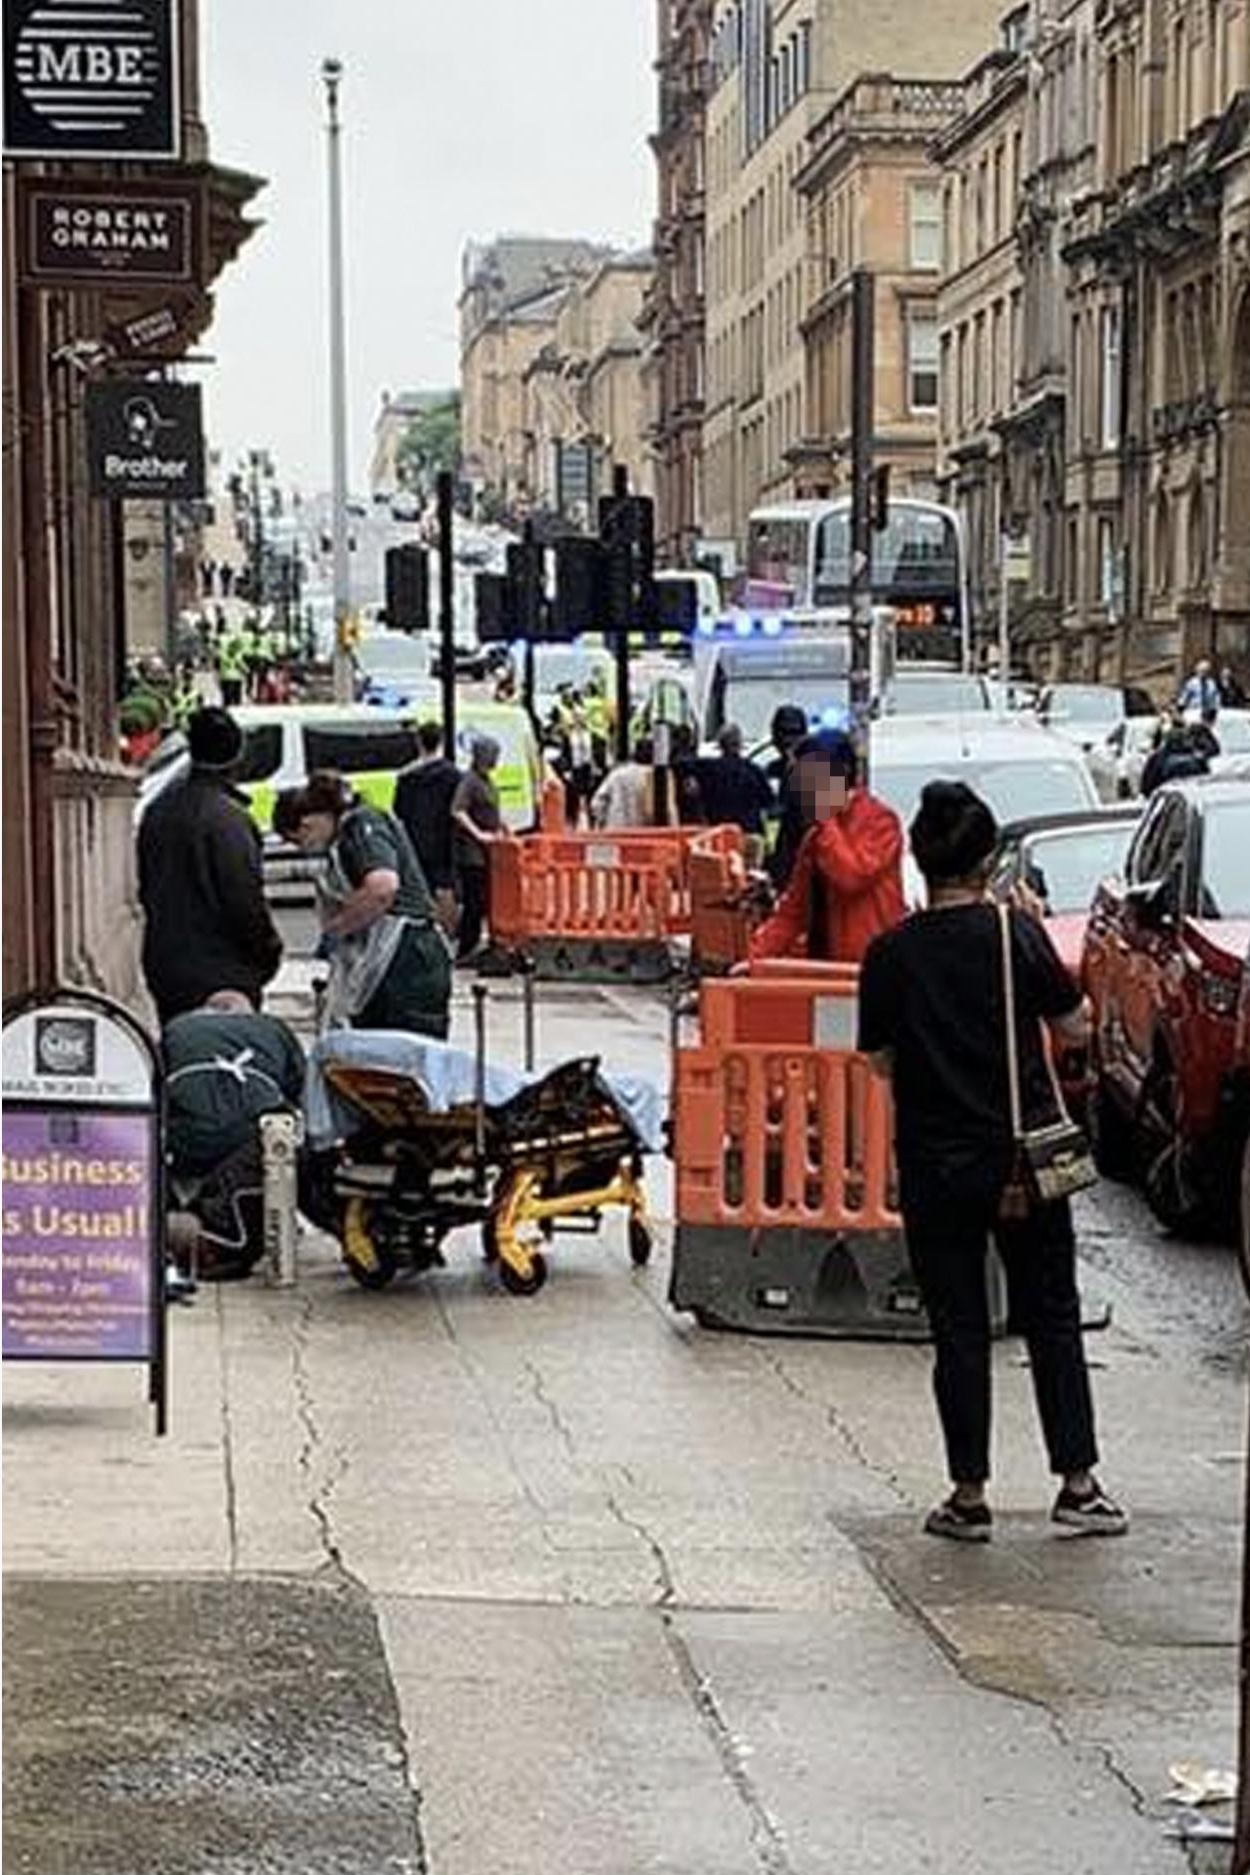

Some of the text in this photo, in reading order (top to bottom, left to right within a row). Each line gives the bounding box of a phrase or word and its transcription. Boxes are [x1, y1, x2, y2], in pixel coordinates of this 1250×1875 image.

[37, 43, 143, 82] MBE
[53, 208, 167, 230] ROBERT
[52, 227, 169, 250] GRAHAM
[104, 455, 188, 479] Brother
